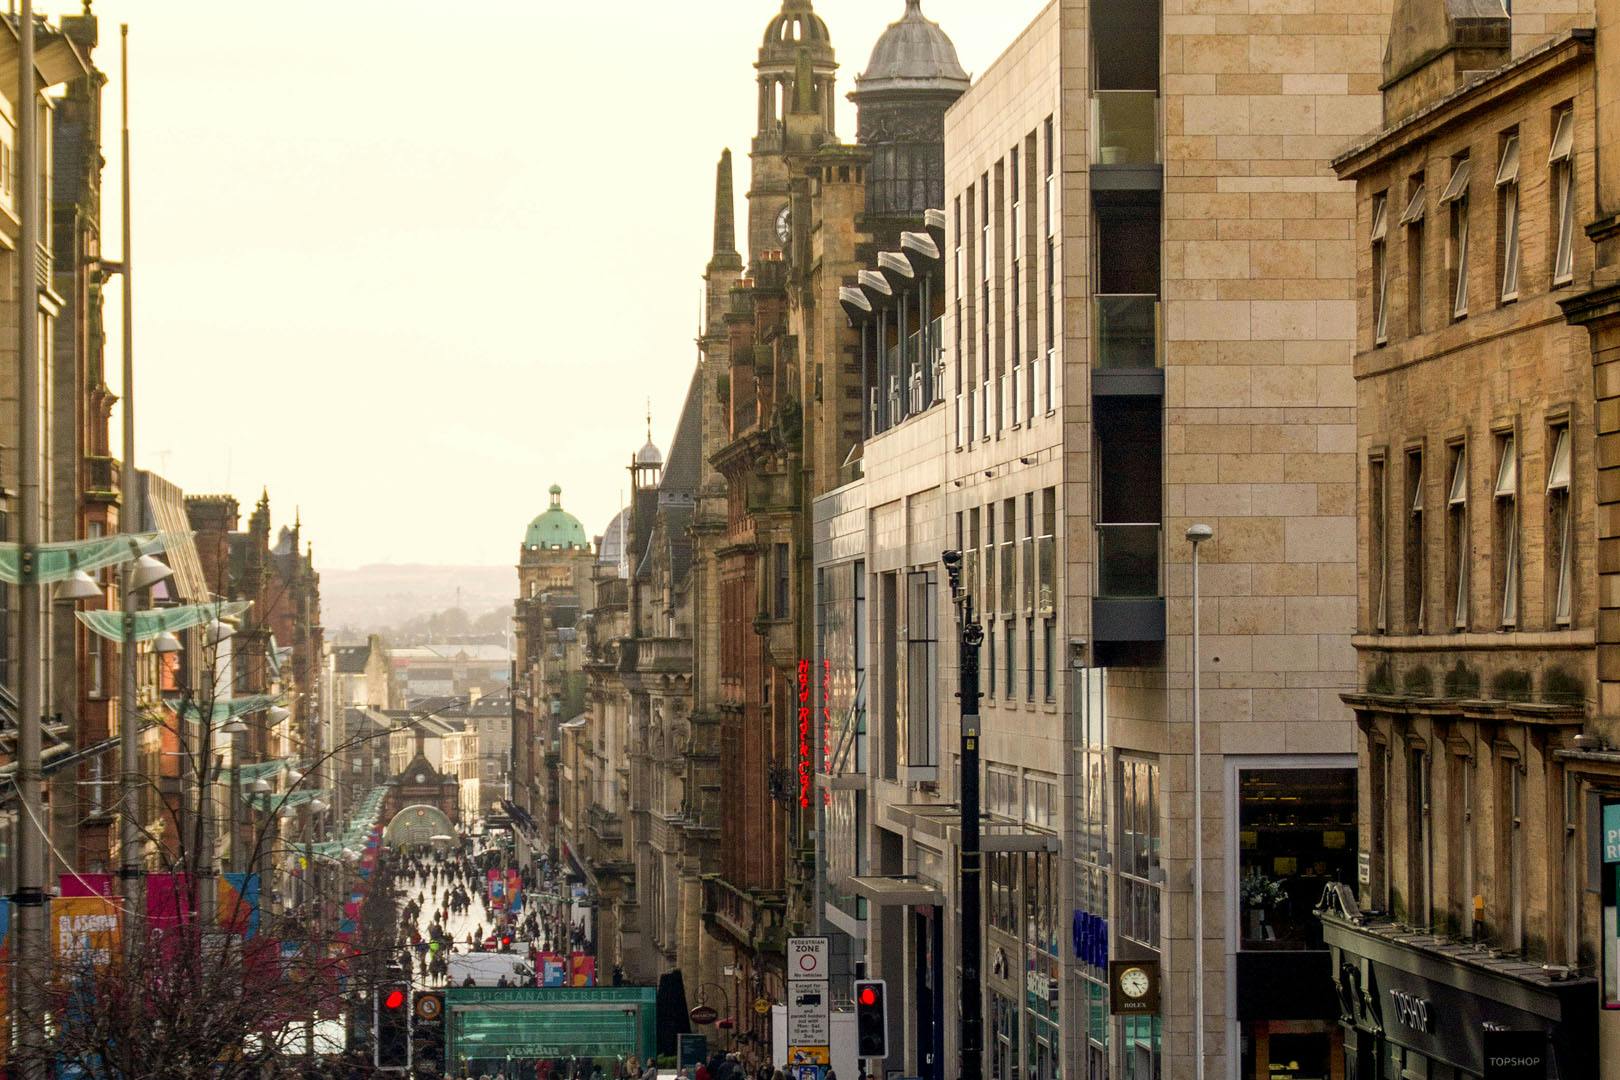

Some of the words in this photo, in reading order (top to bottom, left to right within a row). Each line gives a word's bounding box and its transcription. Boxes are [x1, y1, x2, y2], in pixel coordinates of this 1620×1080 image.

[799, 658, 809, 702] Hard
[799, 707, 809, 757] Rock
[798, 760, 809, 809] Cafe
[1608, 831, 1620, 843] P
[1607, 845, 1620, 858] R
[473, 991, 555, 1000] BUCHANAN
[561, 991, 620, 1000] STREET
[1390, 990, 1428, 1033] TOPSHOP
[1489, 1057, 1540, 1067] TOPSHOP
